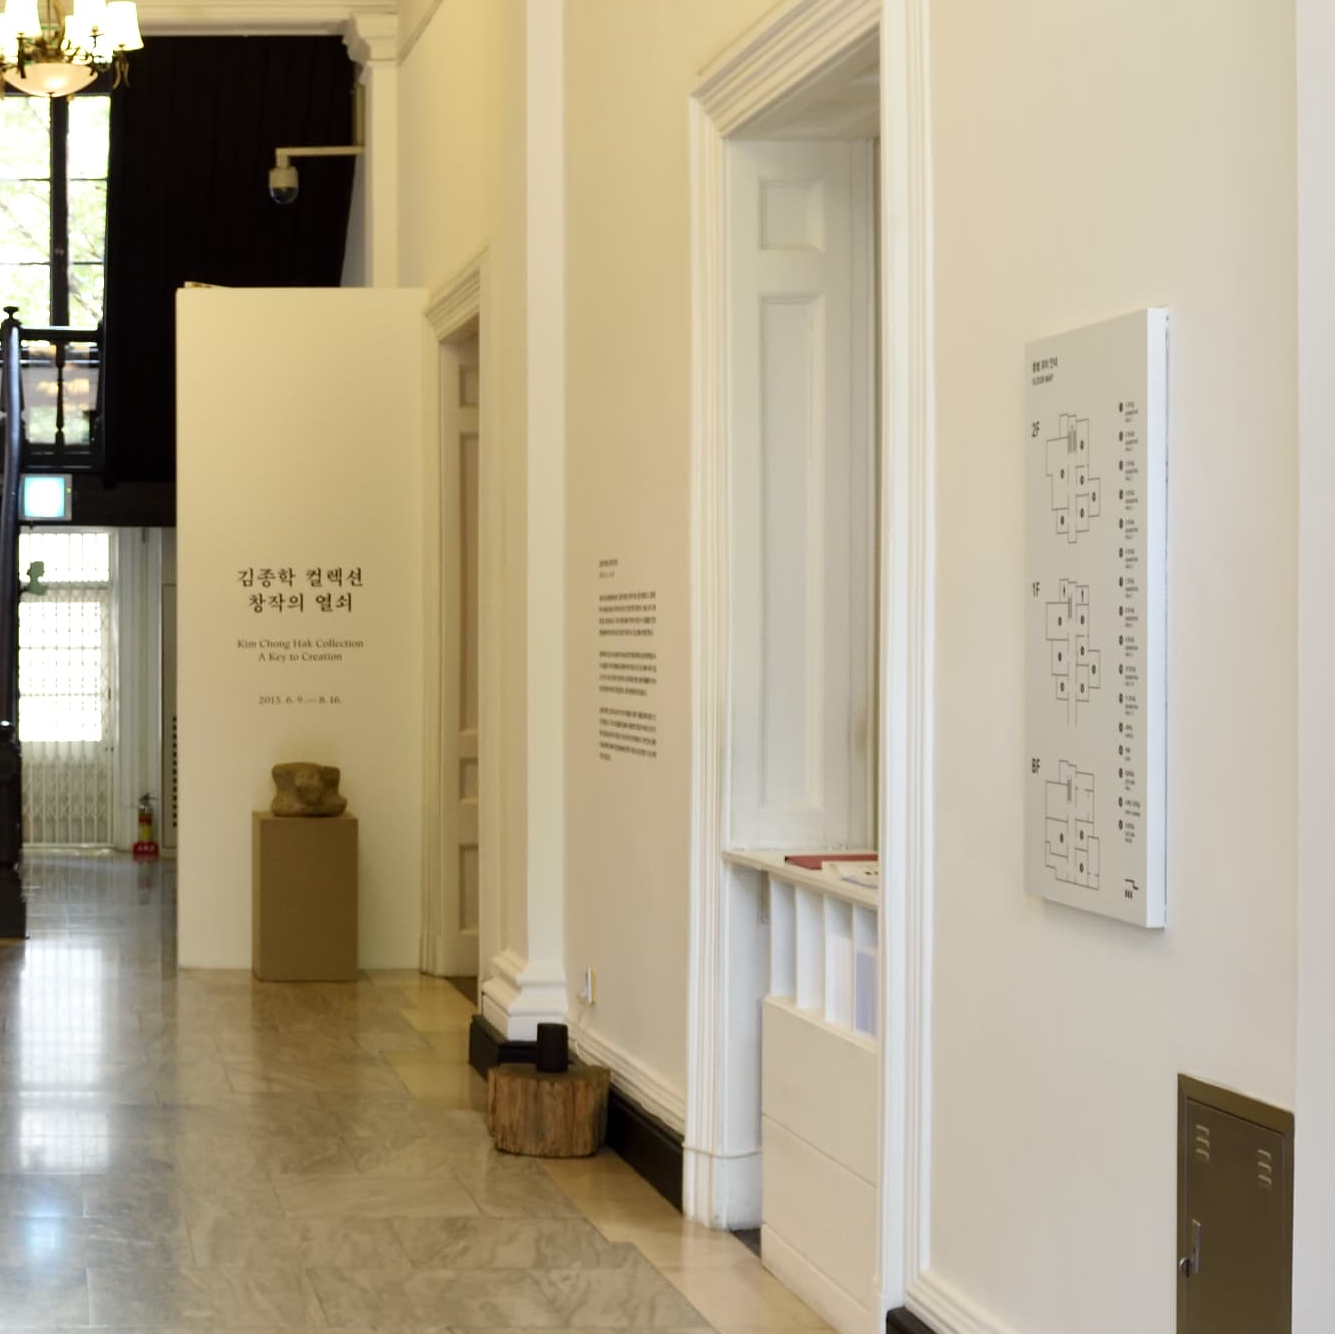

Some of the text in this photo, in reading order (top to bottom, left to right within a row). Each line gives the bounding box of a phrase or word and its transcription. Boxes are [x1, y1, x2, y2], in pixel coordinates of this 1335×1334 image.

[1032, 420, 1040, 438] 2F
[238, 567, 363, 588] 김종학 컬렉션
[249, 592, 352, 613] 창작의 열쇠
[237, 638, 364, 650] Kim Chong Hak Collection
[258, 652, 343, 663] A Key to Creation
